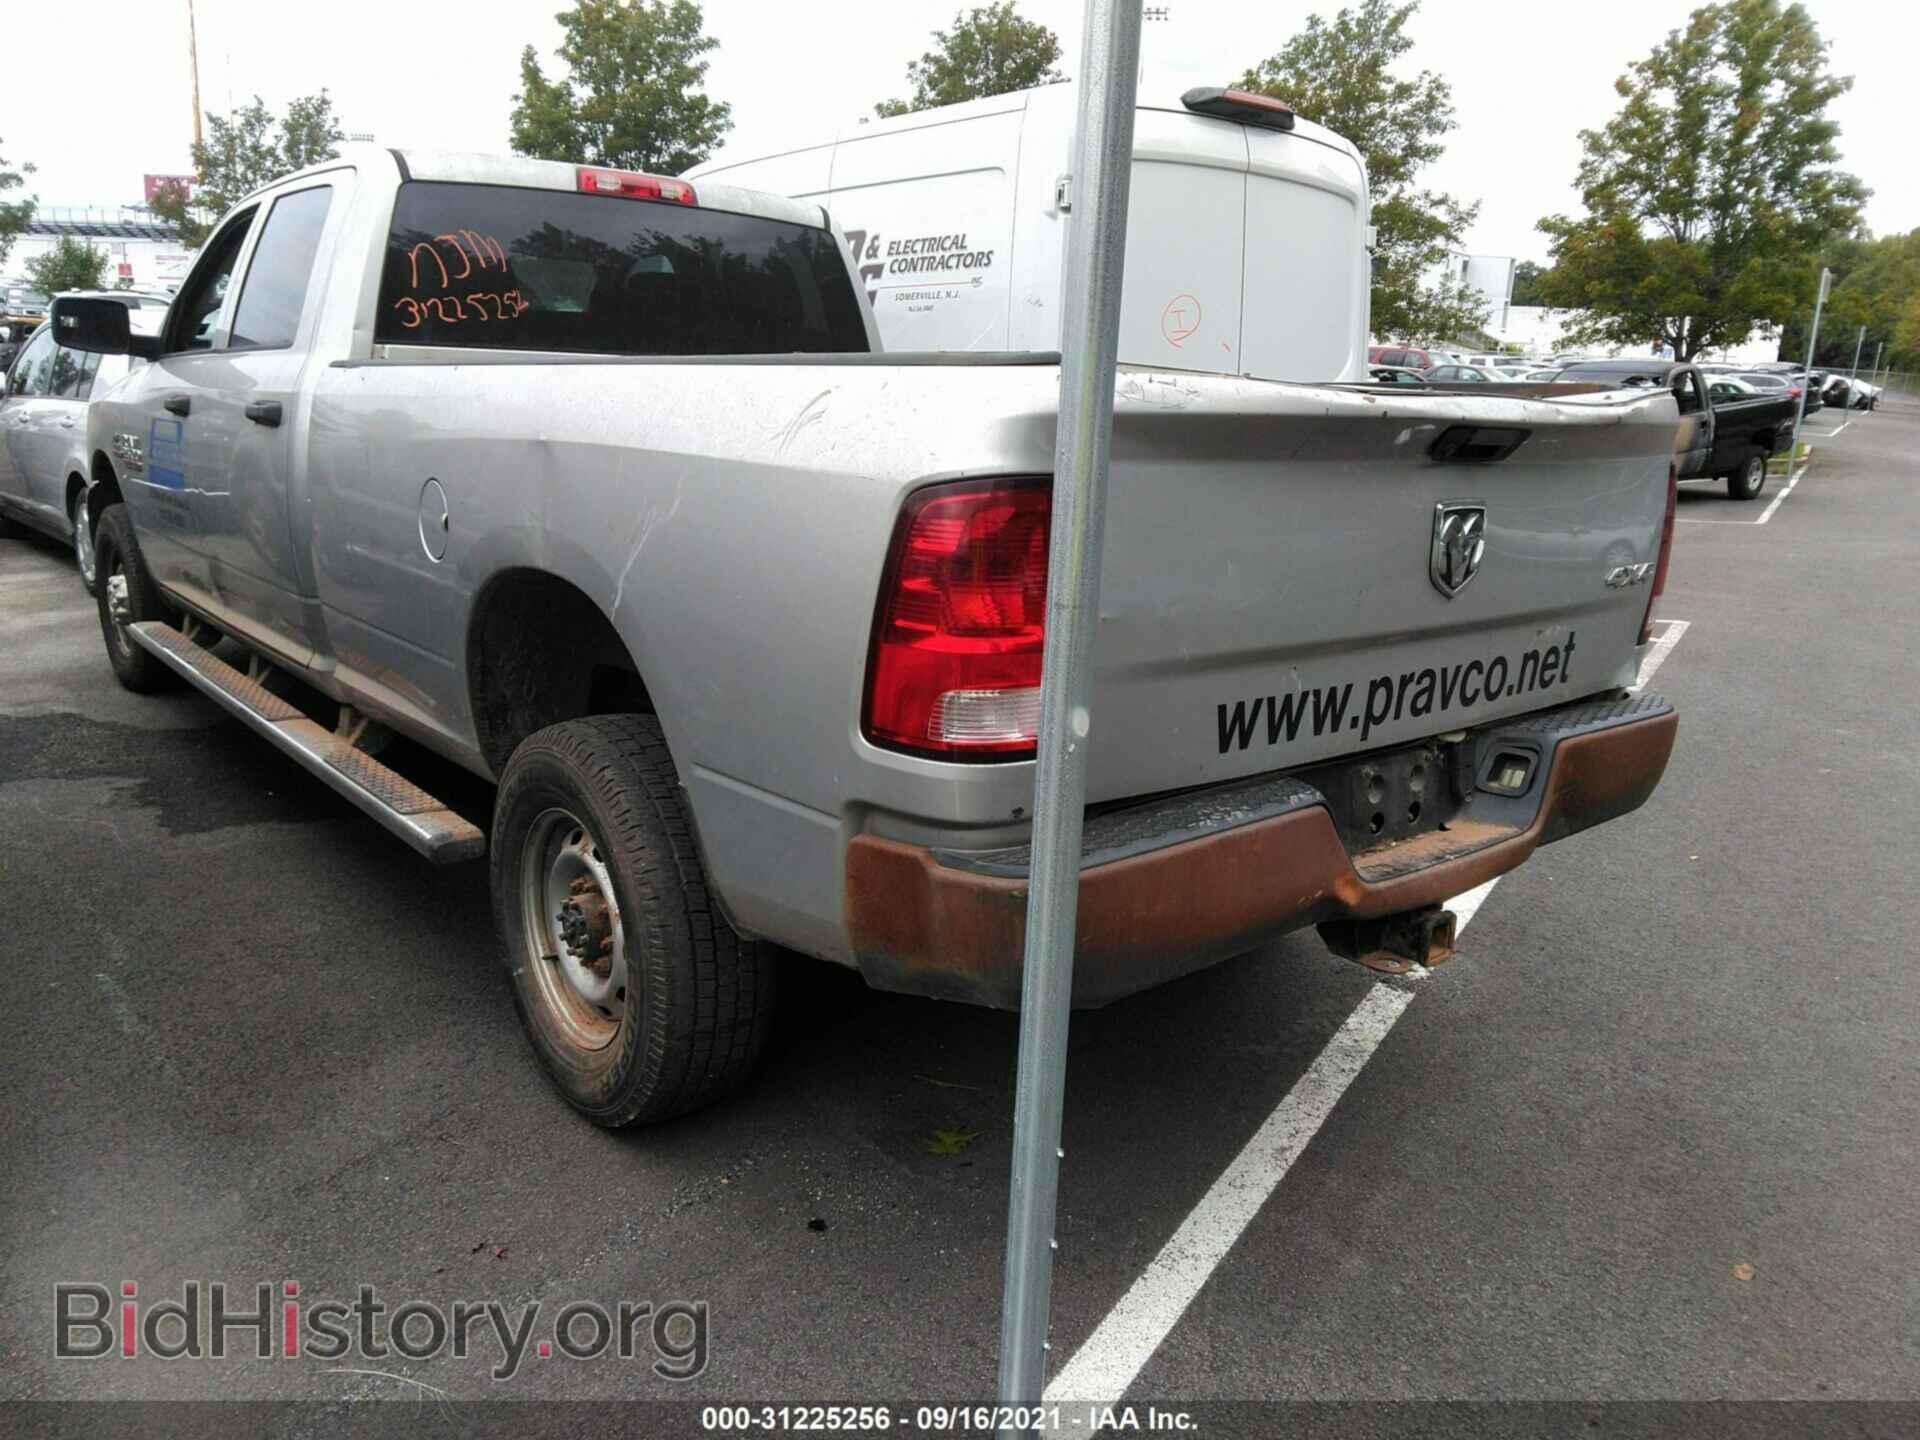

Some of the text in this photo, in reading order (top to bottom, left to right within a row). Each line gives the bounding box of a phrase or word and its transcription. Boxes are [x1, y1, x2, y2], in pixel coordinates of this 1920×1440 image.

[887, 234, 967, 256] ELECTRICAL
[890, 250, 993, 273] CONTRACTORS
[1217, 632, 1575, 753] www.pravco.net
